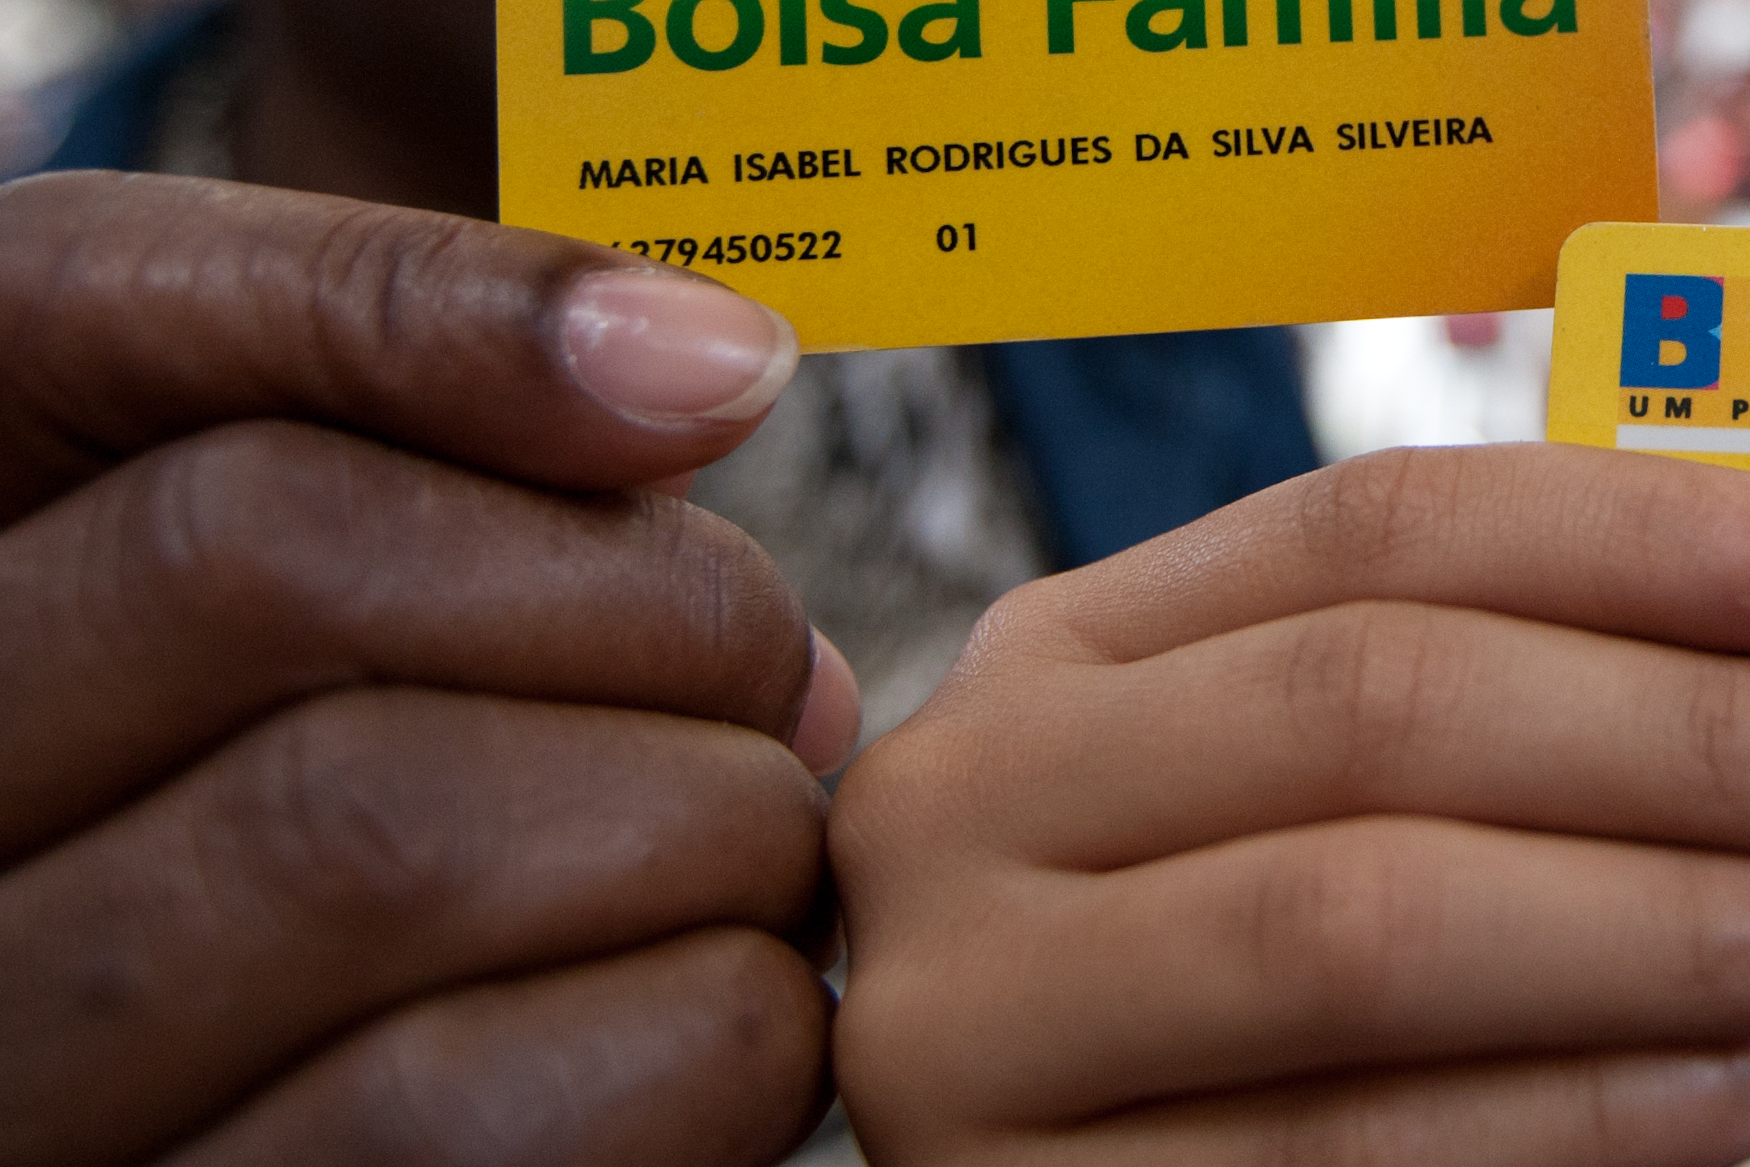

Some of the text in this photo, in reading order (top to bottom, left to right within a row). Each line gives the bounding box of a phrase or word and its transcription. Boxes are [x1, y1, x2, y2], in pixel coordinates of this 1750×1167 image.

[578, 116, 1493, 190] MARIA ISABEL RODRIGUES DA SILVA SILVEIRA
[936, 222, 976, 253] 01
[1629, 395, 1692, 419] UM
